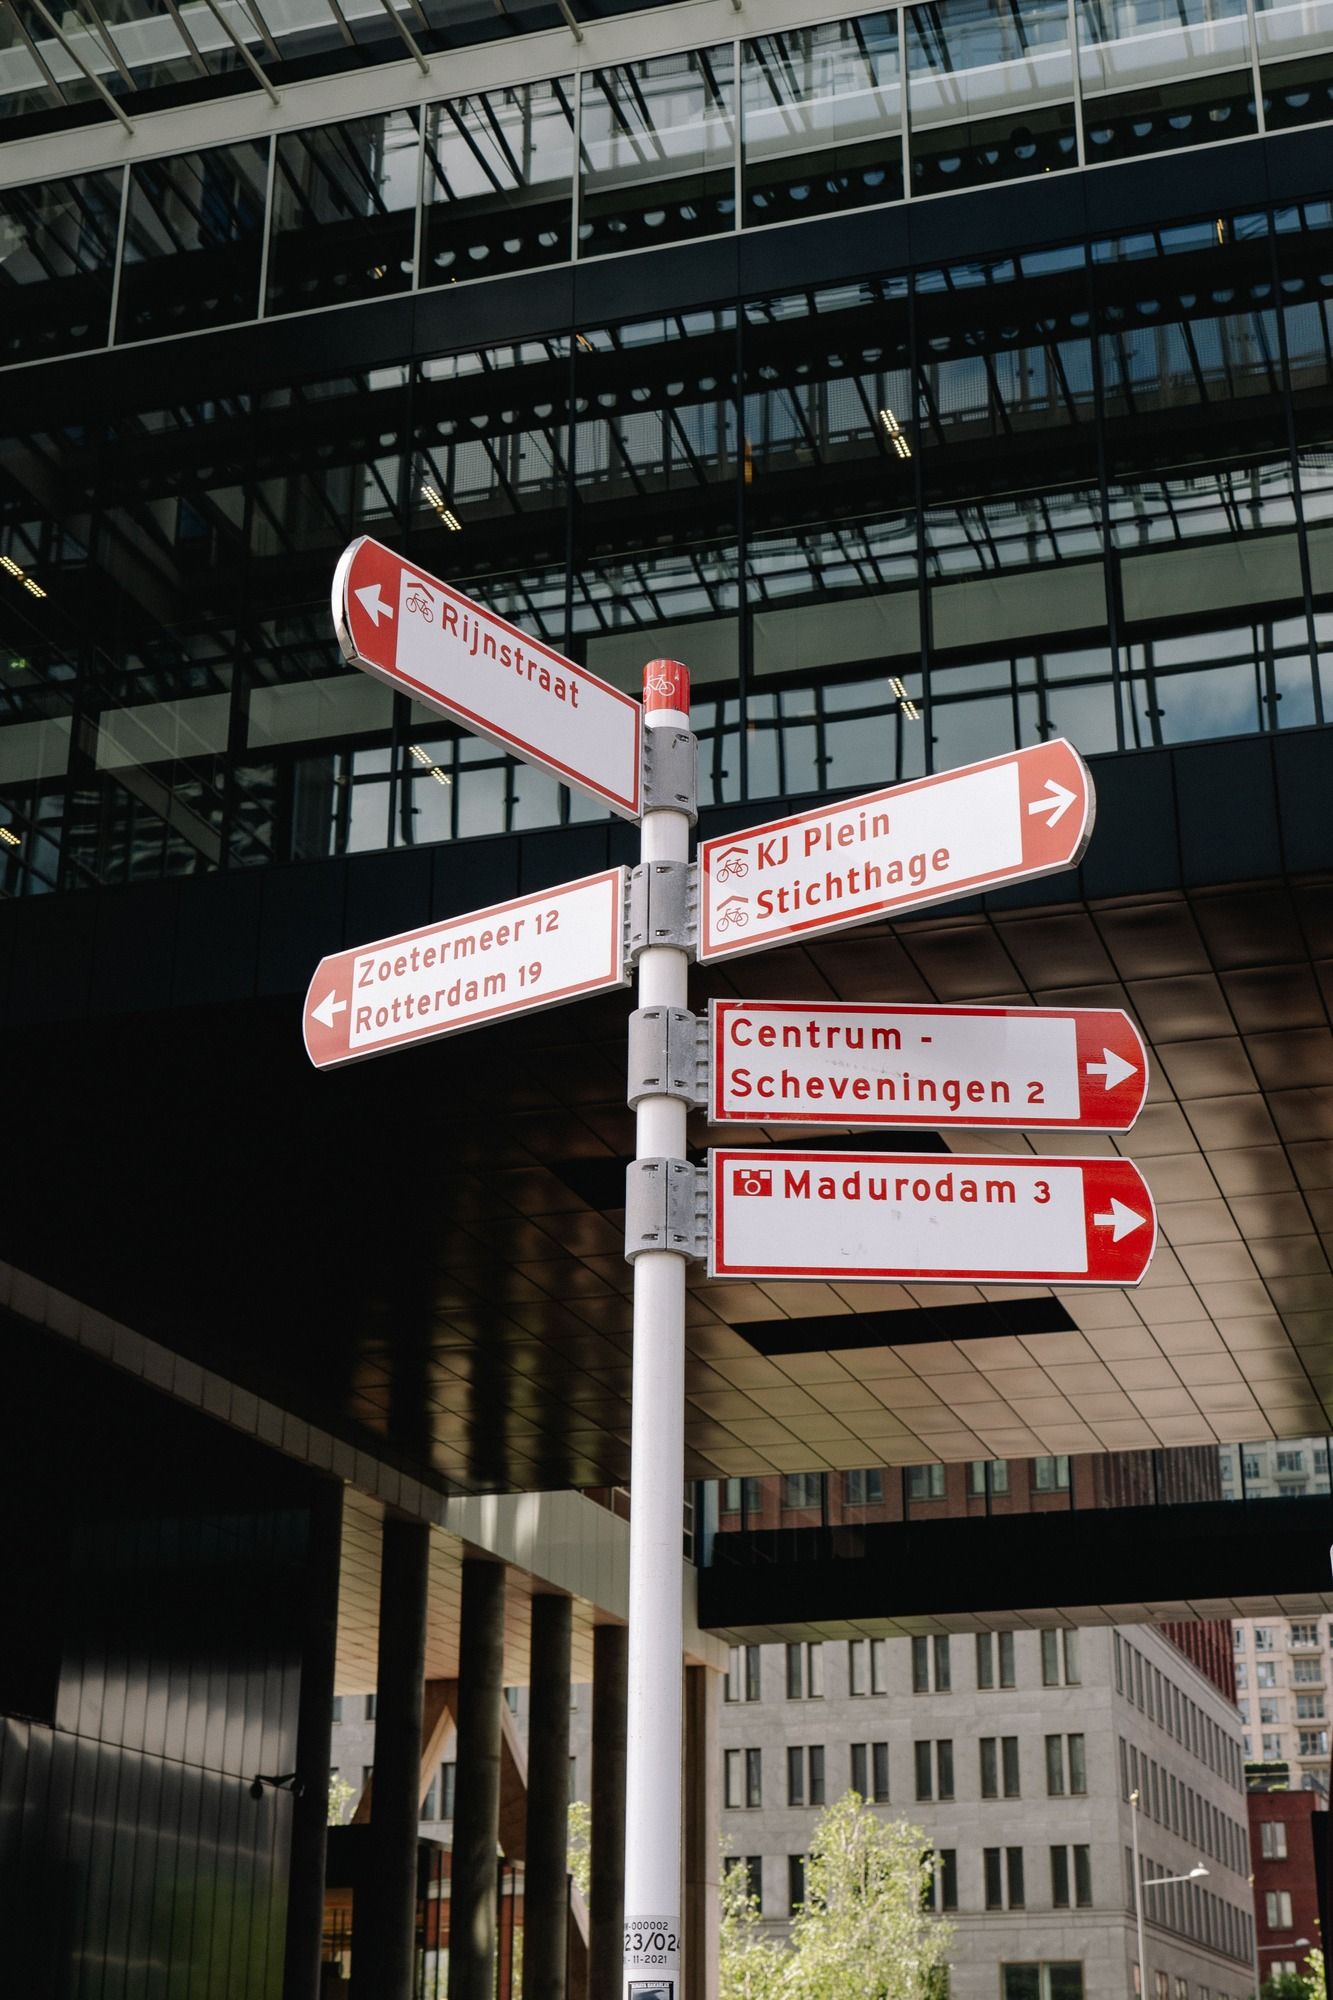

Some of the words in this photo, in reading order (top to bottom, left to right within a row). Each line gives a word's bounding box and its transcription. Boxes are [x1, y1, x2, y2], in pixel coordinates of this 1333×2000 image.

[442, 602, 579, 709] Rijnstraat
[757, 834, 789, 871] KJ
[804, 811, 890, 857] Plein
[756, 847, 951, 920] Stichthage
[358, 919, 525, 989] Zoetermeer
[535, 909, 560, 936] 12
[355, 972, 506, 1034] Rotterdam
[518, 961, 543, 986] 19
[730, 1018, 901, 1051] Centrum
[920, 1035, 933, 1045] -
[730, 1068, 1011, 1112] Scheveningen
[1026, 1081, 1046, 1105] 2
[784, 1168, 1016, 1204] Madurodam
[1033, 1180, 1052, 1205] 3
[624, 1955, 668, 1964] -11-2021
